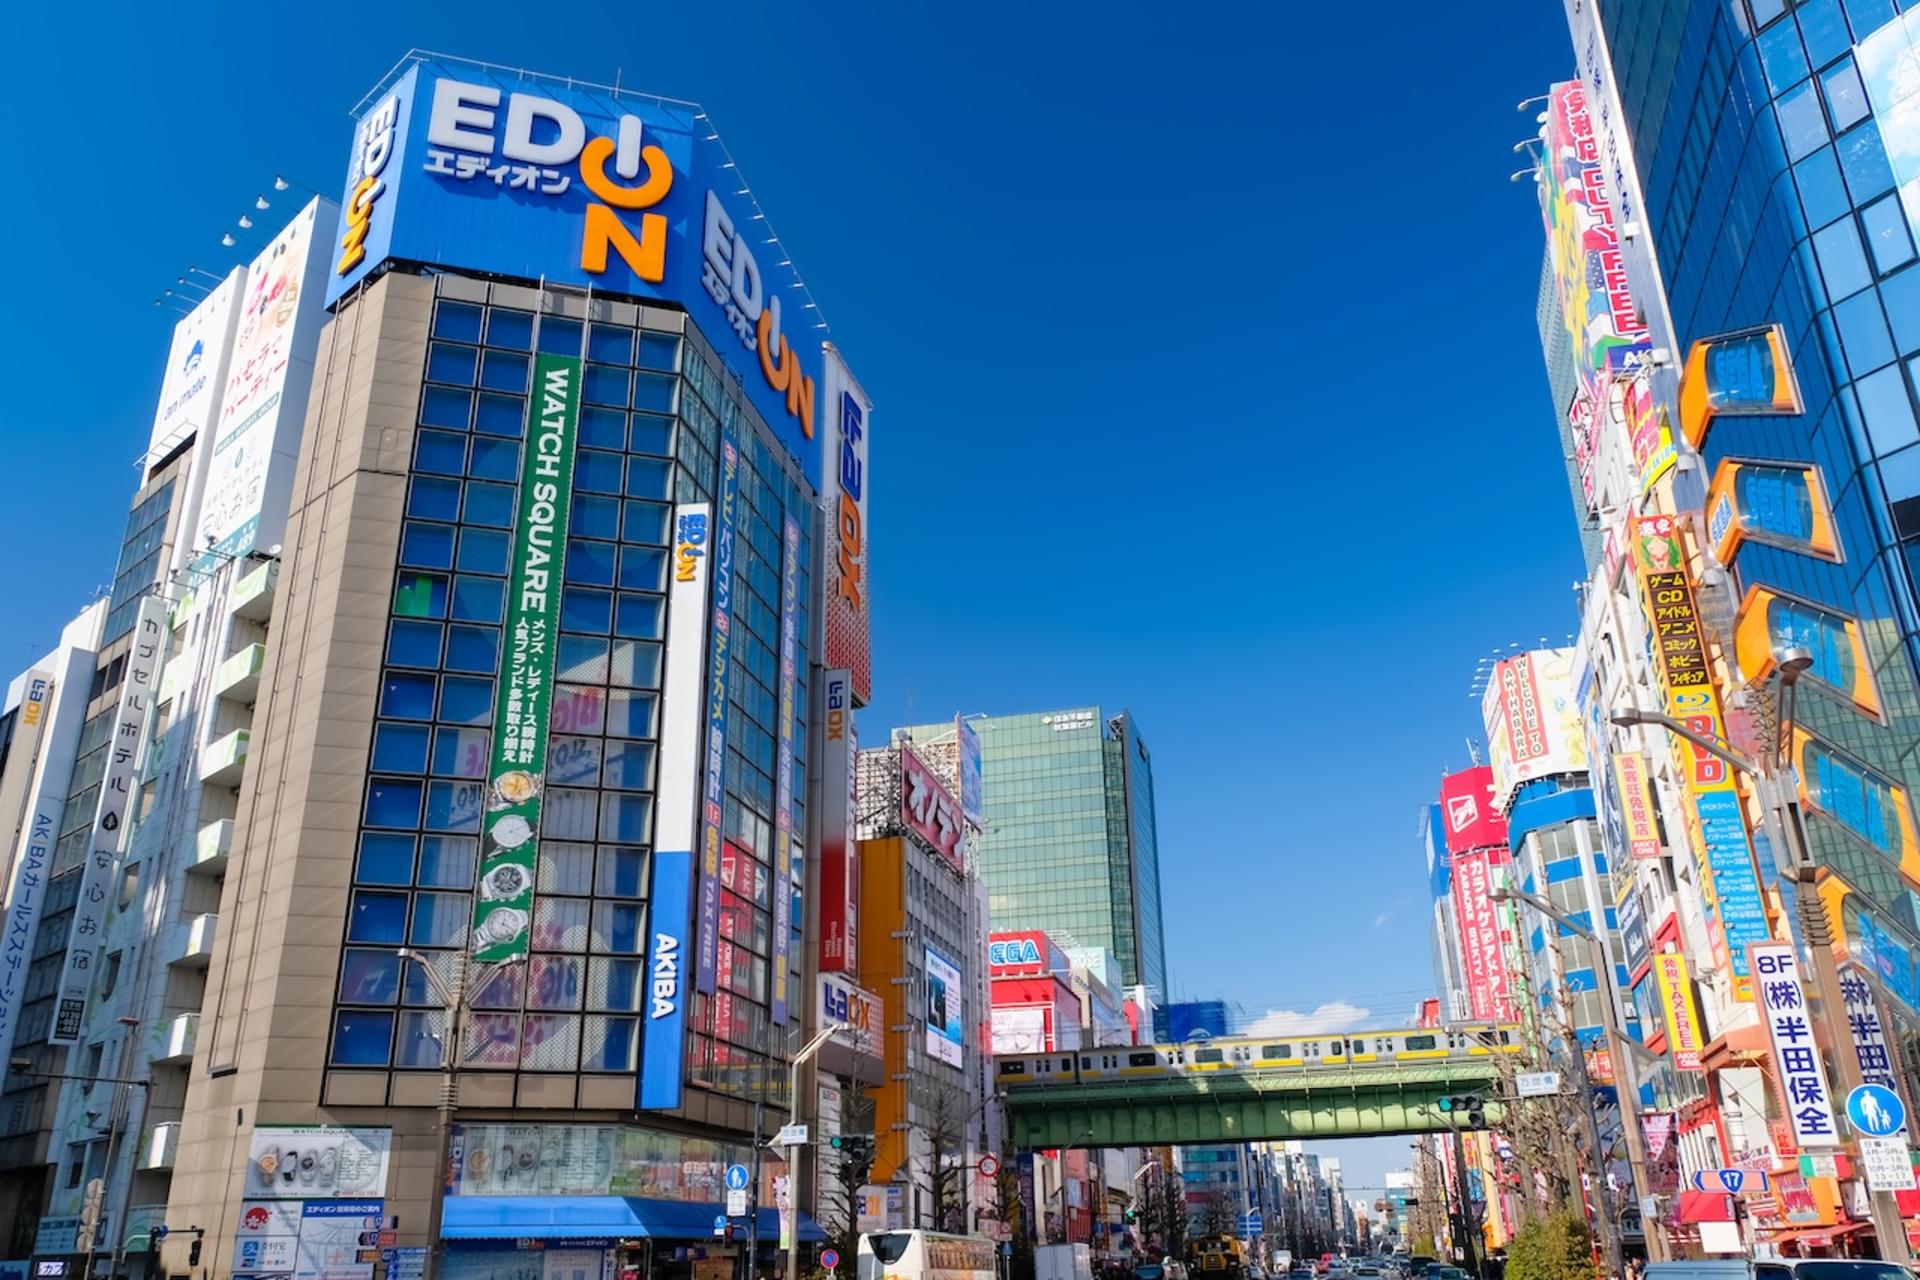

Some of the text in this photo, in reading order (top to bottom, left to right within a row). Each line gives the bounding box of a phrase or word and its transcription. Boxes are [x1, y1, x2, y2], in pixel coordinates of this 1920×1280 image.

[336, 95, 398, 276] EDION
[423, 150, 572, 195] エディオン
[427, 77, 674, 282] EDION
[703, 261, 757, 352] エディオン
[704, 189, 815, 440] EDION
[520, 368, 569, 613] WATCH SQUARE
[676, 513, 706, 582] EDION
[1650, 575, 1684, 589] ゲーム
[1656, 606, 1691, 620] アイドル
[1657, 590, 1683, 604] CD
[1659, 621, 1696, 636] アニメ
[1663, 638, 1697, 651] コミック
[1669, 655, 1700, 668] ホビー
[110, 616, 158, 794] カプセルホテル
[502, 616, 530, 763] 人気ブランド多数取り揃え
[518, 619, 547, 764] メンズ・レディース腕時計
[1505, 669, 1528, 759] AKIHABARA
[1516, 658, 1542, 754] WELCOME TO
[0, 814, 53, 1040] AKIBAガールズステーショ
[702, 880, 715, 970] TAX FREE
[1469, 860, 1491, 929] カラオケ
[652, 931, 679, 1020] AKIBA
[990, 938, 1040, 965] EGA
[1757, 955, 1793, 975] 8F
[1669, 982, 1694, 1049] TAX FREE
[1724, 1172, 1740, 1187] 17
